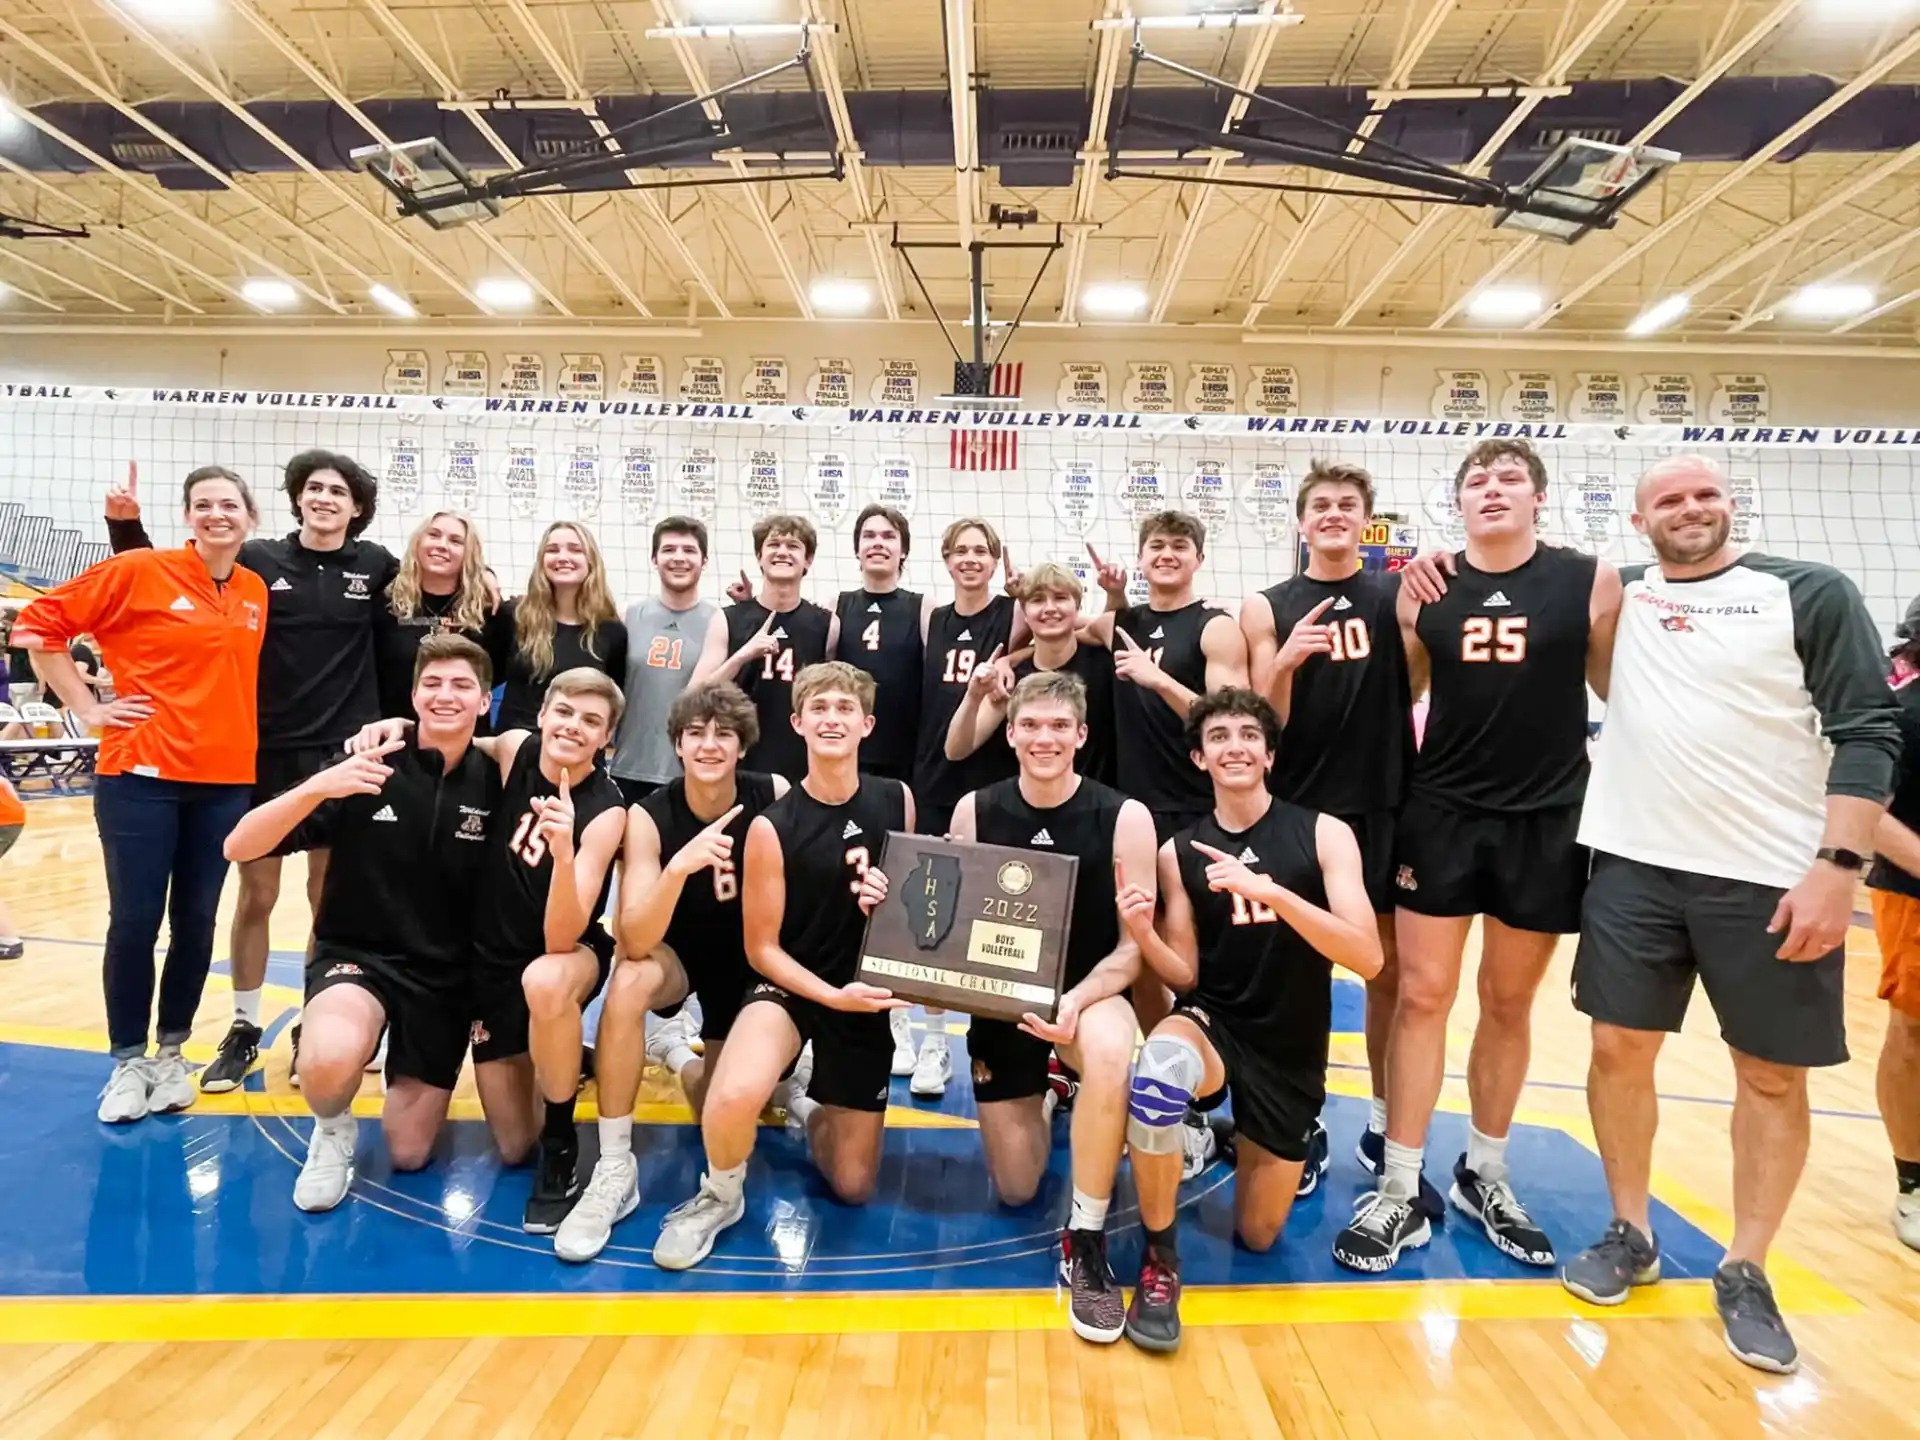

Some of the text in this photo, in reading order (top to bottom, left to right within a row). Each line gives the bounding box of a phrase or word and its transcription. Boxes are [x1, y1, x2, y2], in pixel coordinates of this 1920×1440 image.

[885, 369, 917, 377] SOCCER
[1200, 366, 1229, 374] ASHLEY
[0, 384, 73, 398] YBALL
[152, 389, 398, 409] WARREN VOLLEYBALL
[816, 391, 849, 399] FINALS
[1195, 397, 1234, 405] CHAMPION
[484, 399, 755, 419] WARREN VOLLEYBALL
[849, 408, 1142, 428] WARREN VOLLEYBALL
[1512, 405, 1555, 413] CHAMPION
[1247, 416, 1568, 438] WARREN VOLLEYBALL
[1681, 427, 1819, 444] WARREN
[1121, 492, 1164, 500] CHAMPION
[1385, 547, 1412, 557] GUEST
[861, 619, 881, 651] 4
[1328, 617, 1371, 661] 10
[1461, 616, 1528, 663] 25
[647, 636, 684, 670] 21
[761, 648, 794, 682] 14
[942, 649, 976, 683] 19
[924, 858, 937, 939] IHSA
[982, 897, 1038, 923] 2022
[995, 933, 1015, 946] BOYS
[981, 943, 1025, 960] VOLLEYBALL
[871, 960, 947, 984] SECTIONAL
